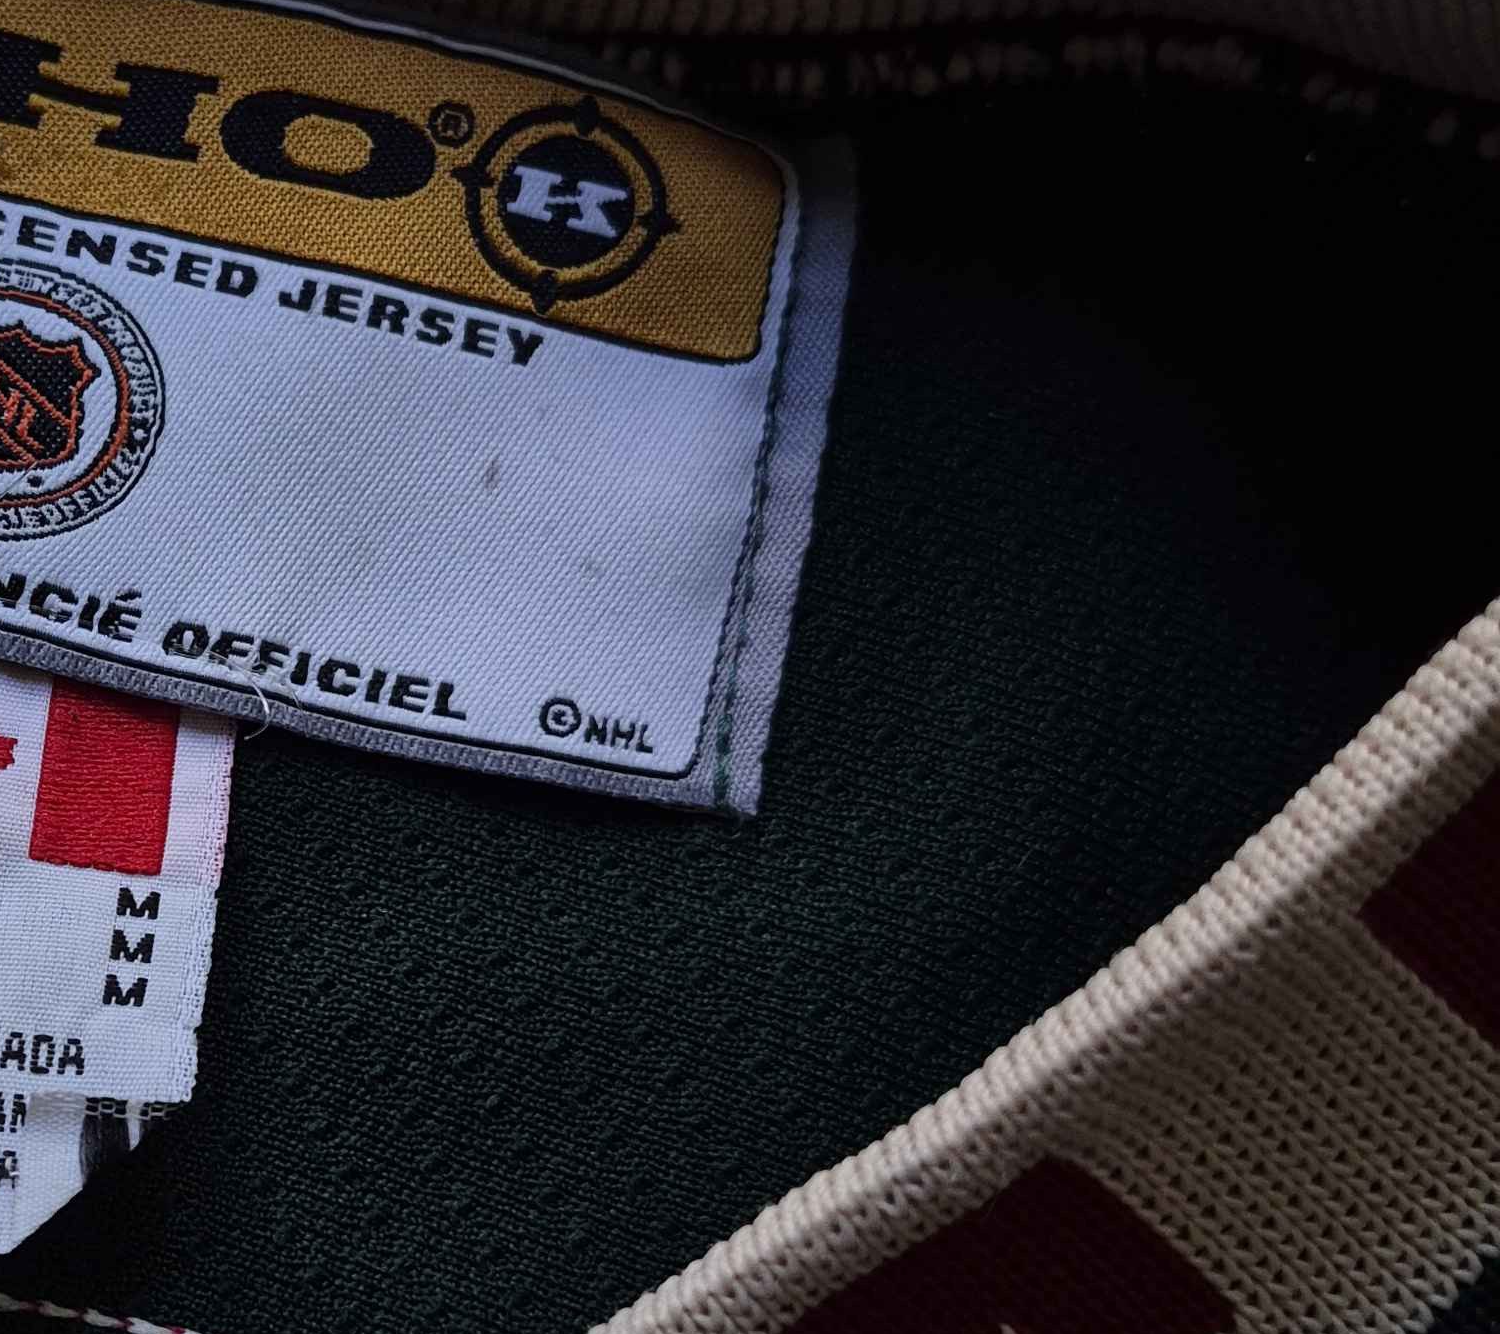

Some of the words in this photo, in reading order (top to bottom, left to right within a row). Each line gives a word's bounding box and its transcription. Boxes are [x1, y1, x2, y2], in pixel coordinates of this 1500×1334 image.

[506, 165, 628, 239] K
[277, 278, 545, 366] JERSEY
[162, 619, 469, 722] OFFICIEL
[116, 887, 161, 920] M
[109, 929, 155, 964] M
[102, 973, 149, 1007] M
